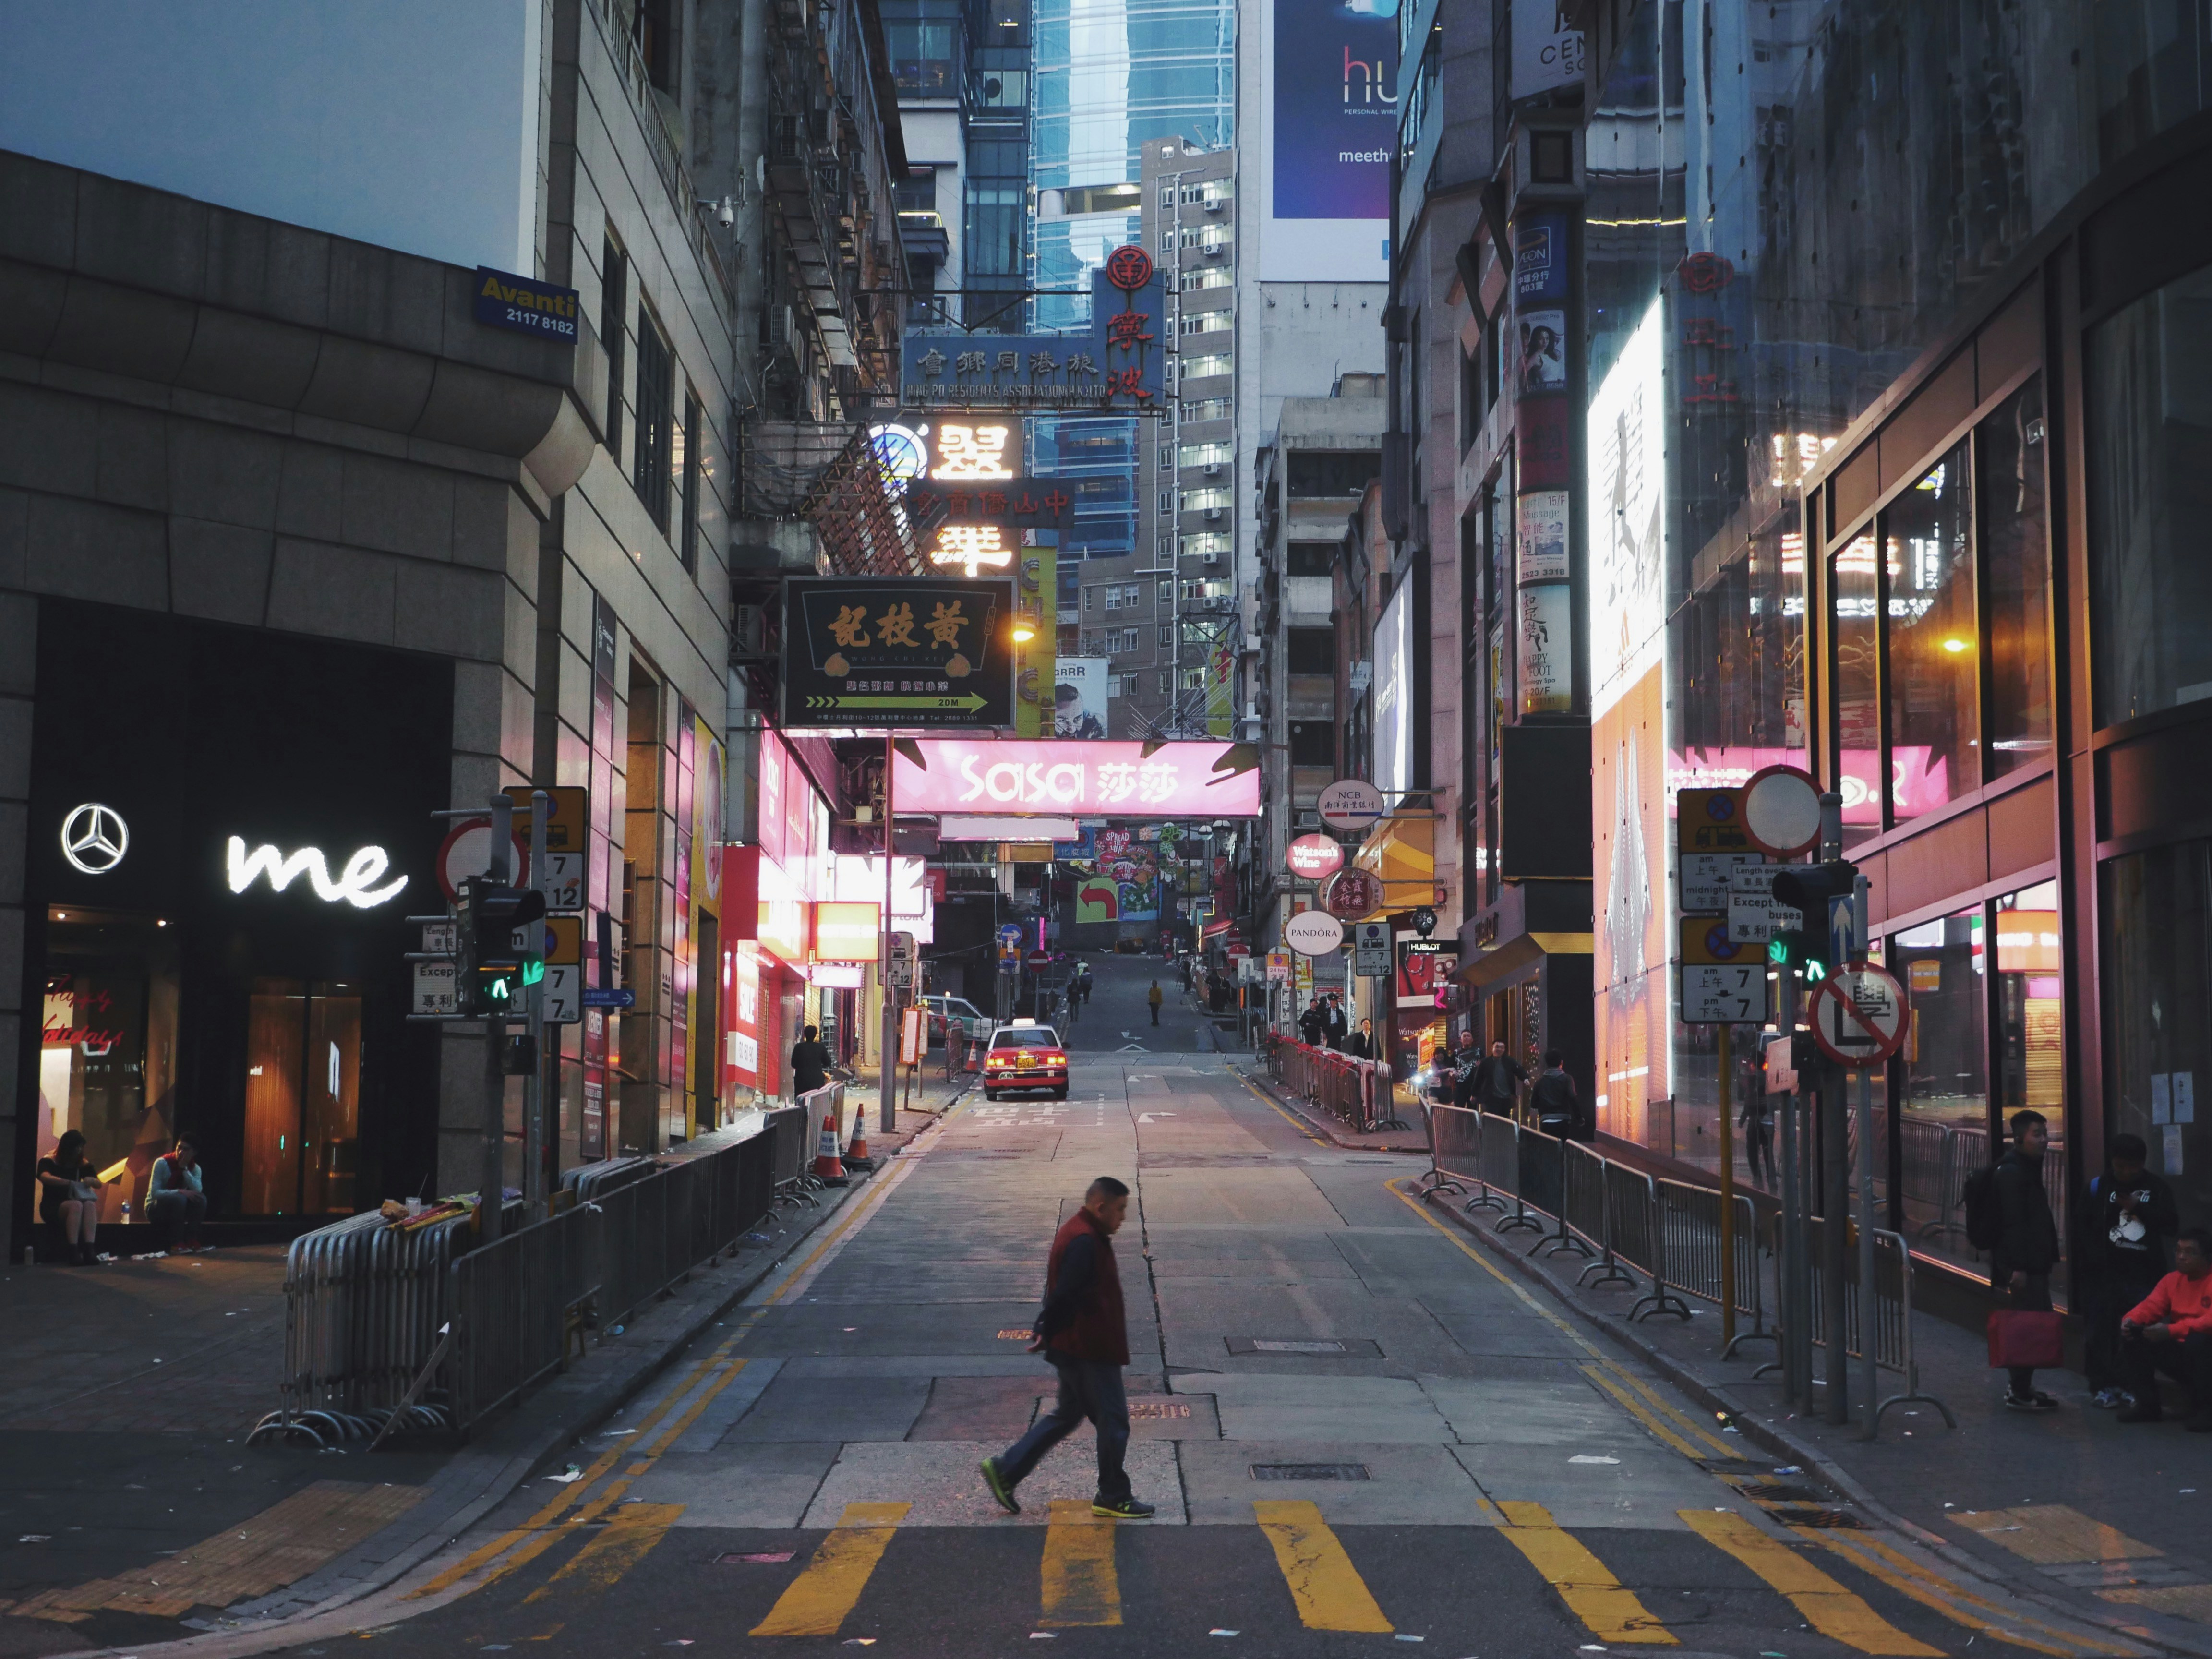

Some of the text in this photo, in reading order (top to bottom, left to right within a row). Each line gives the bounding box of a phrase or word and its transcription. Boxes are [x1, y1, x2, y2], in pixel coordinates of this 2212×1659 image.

[1339, 147, 1392, 163] meeth
[481, 277, 574, 318] Avanti
[507, 308, 574, 335] 2117 8182
[1106, 309, 1154, 397] 寧波
[949, 384, 999, 398] RESIDENTS
[1548, 495, 1565, 506] 15/F
[1523, 510, 1560, 520] Massage
[1527, 665, 1552, 677] FOOT
[938, 698, 959, 707] 20M
[1097, 762, 1179, 803] 莎莎
[1106, 832, 1130, 841] SPREAD
[1110, 845, 1125, 854] LOVE
[1293, 845, 1339, 857] Watson's
[554, 856, 566, 875] 7
[1293, 856, 1320, 868] Wine
[227, 835, 409, 909] me
[1695, 865, 1719, 876] 上午
[1736, 867, 1763, 875] Length
[1686, 886, 1729, 895] midnight
[553, 888, 577, 906] 12
[1696, 896, 1719, 906] 午夜
[1734, 897, 1773, 909] Except
[1768, 910, 1802, 920] buses
[1291, 927, 1338, 937] PANDORA
[1378, 952, 1384, 961] 7
[420, 966, 456, 978] Excep
[900, 962, 906, 970] 7
[1379, 965, 1390, 974] 12
[552, 970, 565, 988] 7
[900, 975, 910, 984] 12
[1698, 976, 1723, 988] 上午
[1736, 969, 1750, 988] 7
[552, 999, 565, 1018] 7
[1699, 1007, 1723, 1018] 下午
[1737, 998, 1751, 1018] 7
